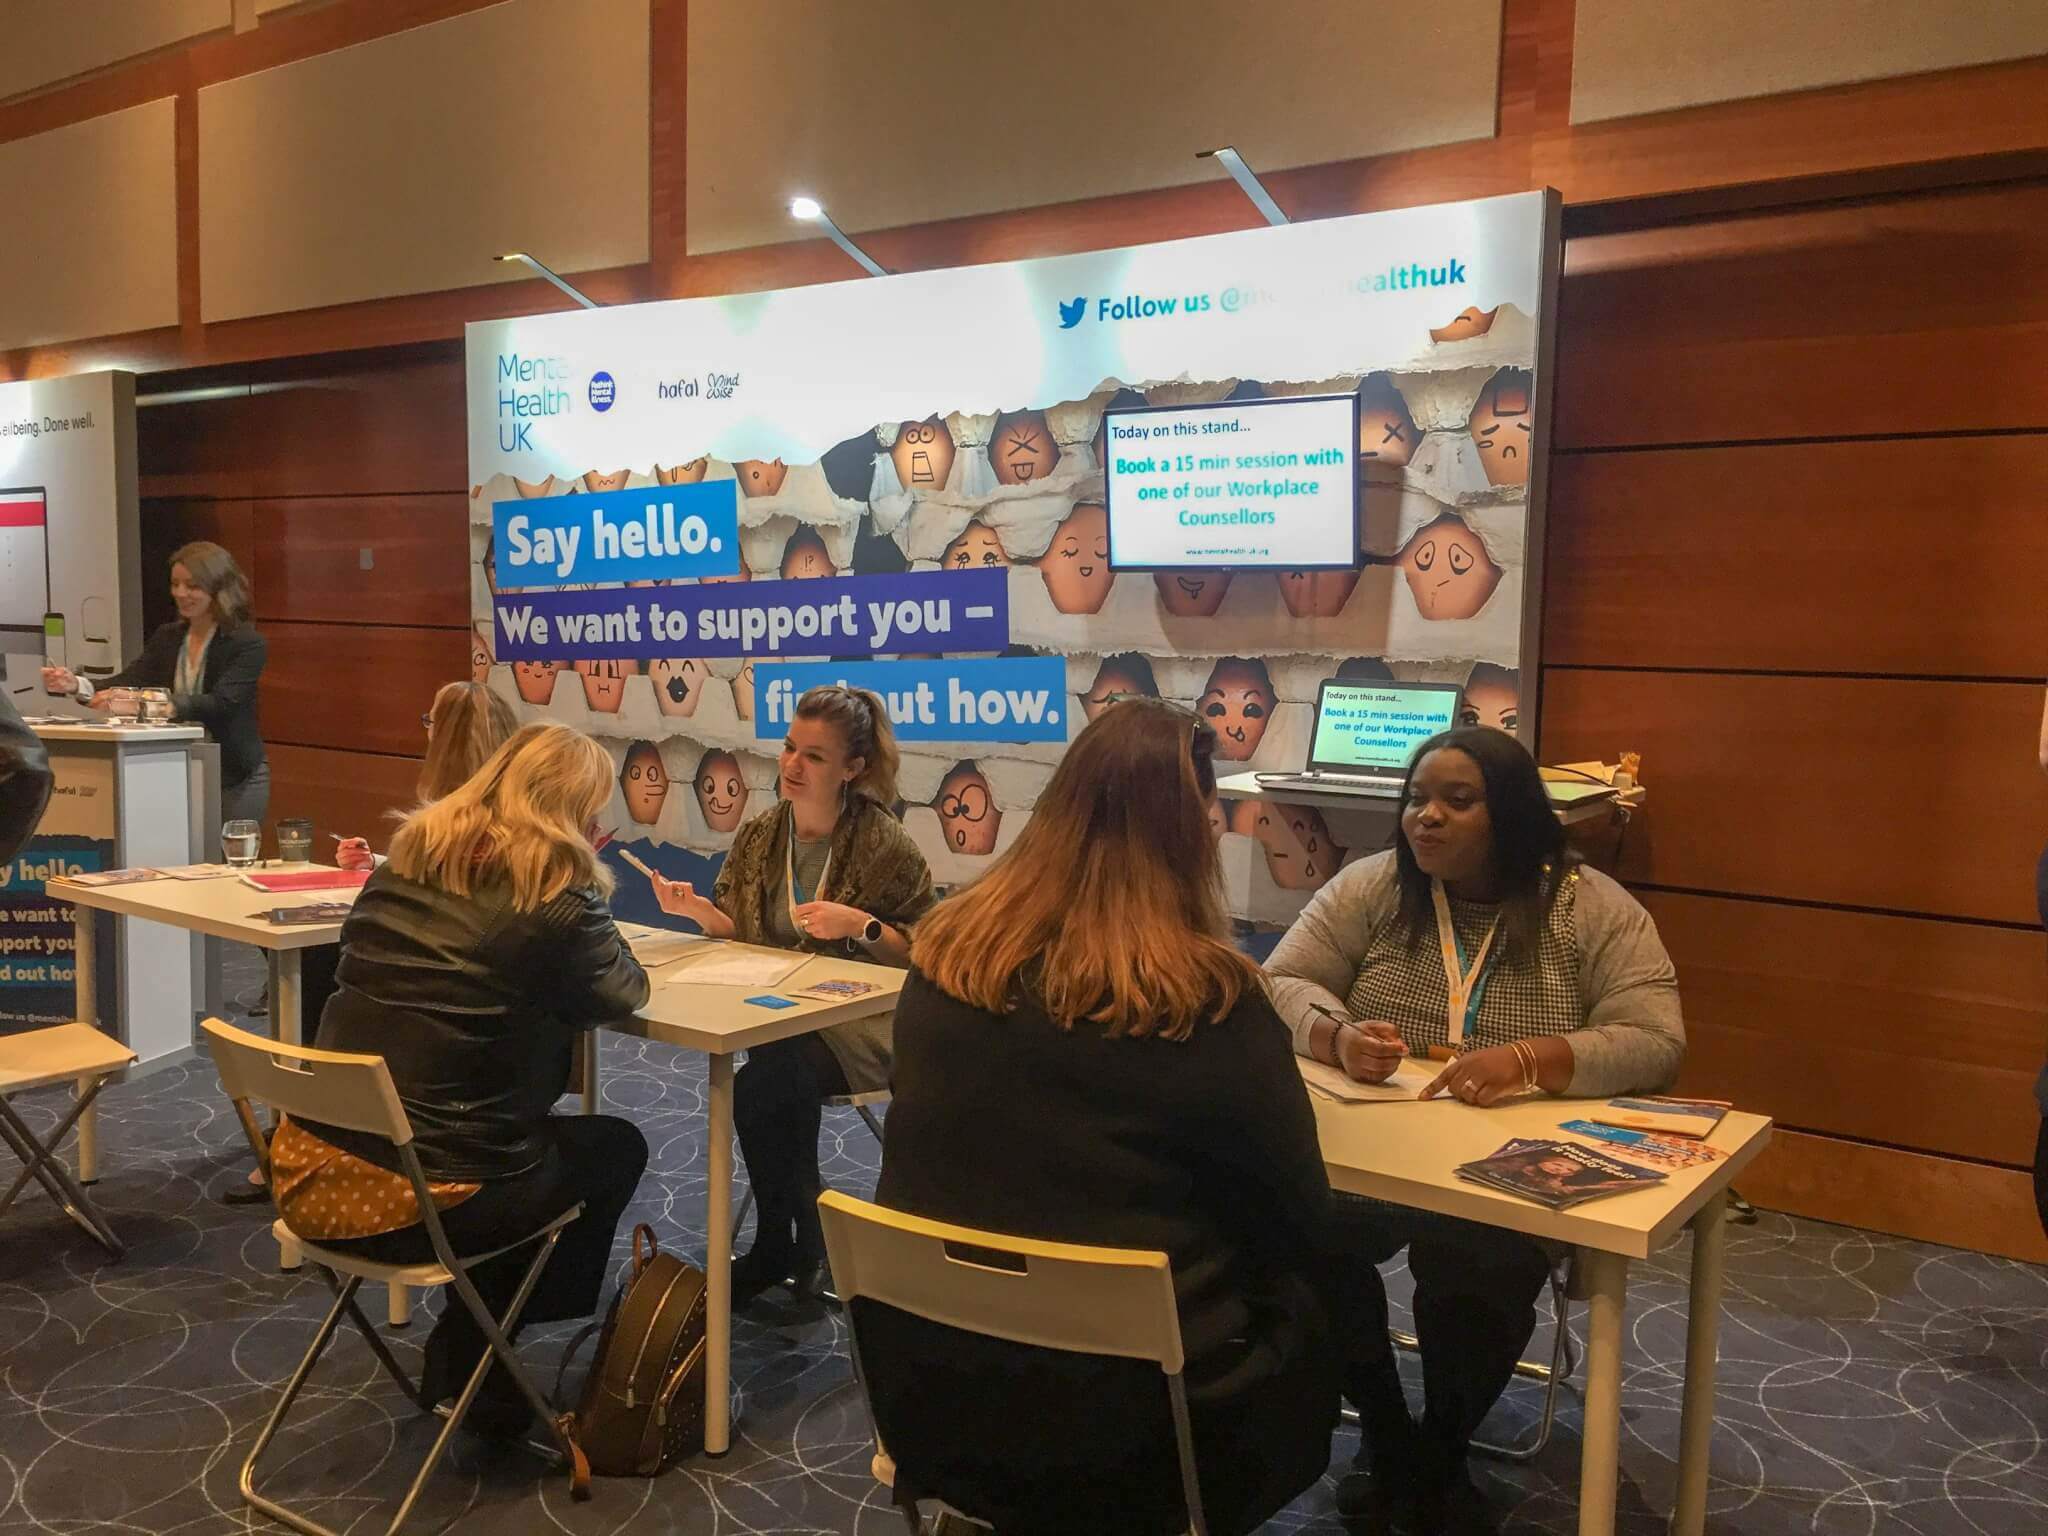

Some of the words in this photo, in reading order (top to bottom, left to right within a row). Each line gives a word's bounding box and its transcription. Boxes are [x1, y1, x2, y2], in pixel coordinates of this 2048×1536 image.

[1098, 297, 1176, 321] Follow
[1184, 293, 1211, 313] us
[498, 353, 571, 384] Menta
[658, 378, 699, 400] hafal
[498, 384, 571, 418] Health
[0, 419, 41, 438] ellbeing.
[44, 416, 69, 432] Done
[72, 412, 95, 429] well.
[1112, 426, 1149, 440] Today
[1153, 427, 1170, 438] on
[1174, 422, 1197, 436] this
[1202, 419, 1251, 434] stand...
[499, 421, 533, 453] UK
[1116, 457, 1155, 475] Book
[1161, 461, 1170, 473] a
[1175, 456, 1194, 472] 15
[1199, 454, 1230, 470] min
[1235, 451, 1297, 469] session
[1304, 447, 1344, 466] with
[1138, 486, 1168, 501] one
[1173, 483, 1190, 499] of
[1194, 484, 1222, 497] our
[1228, 479, 1319, 499] Workplace
[1178, 508, 1276, 526] Counsellors
[507, 515, 580, 578] Say
[592, 503, 722, 560] hello.
[498, 606, 548, 645] We
[555, 604, 642, 644] want
[649, 601, 687, 642] to
[698, 595, 858, 651] support
[867, 599, 950, 649] you
[949, 678, 1060, 727] how.
[1326, 691, 1347, 701] Today
[1360, 693, 1373, 701] this
[1325, 707, 1347, 717] Book
[1358, 710, 1368, 718] 15
[1370, 711, 1388, 719] min
[1390, 712, 1424, 721] session
[1426, 713, 1448, 723] with
[1334, 723, 1351, 731] one
[1353, 722, 1365, 732] of
[1366, 725, 1381, 733] our
[1383, 724, 1433, 736] Workplace
[1354, 735, 1408, 748] Counsellors
[0, 910, 9, 921] e
[12, 907, 58, 922] want
[16, 966, 46, 981] out
[50, 965, 77, 981] ho
